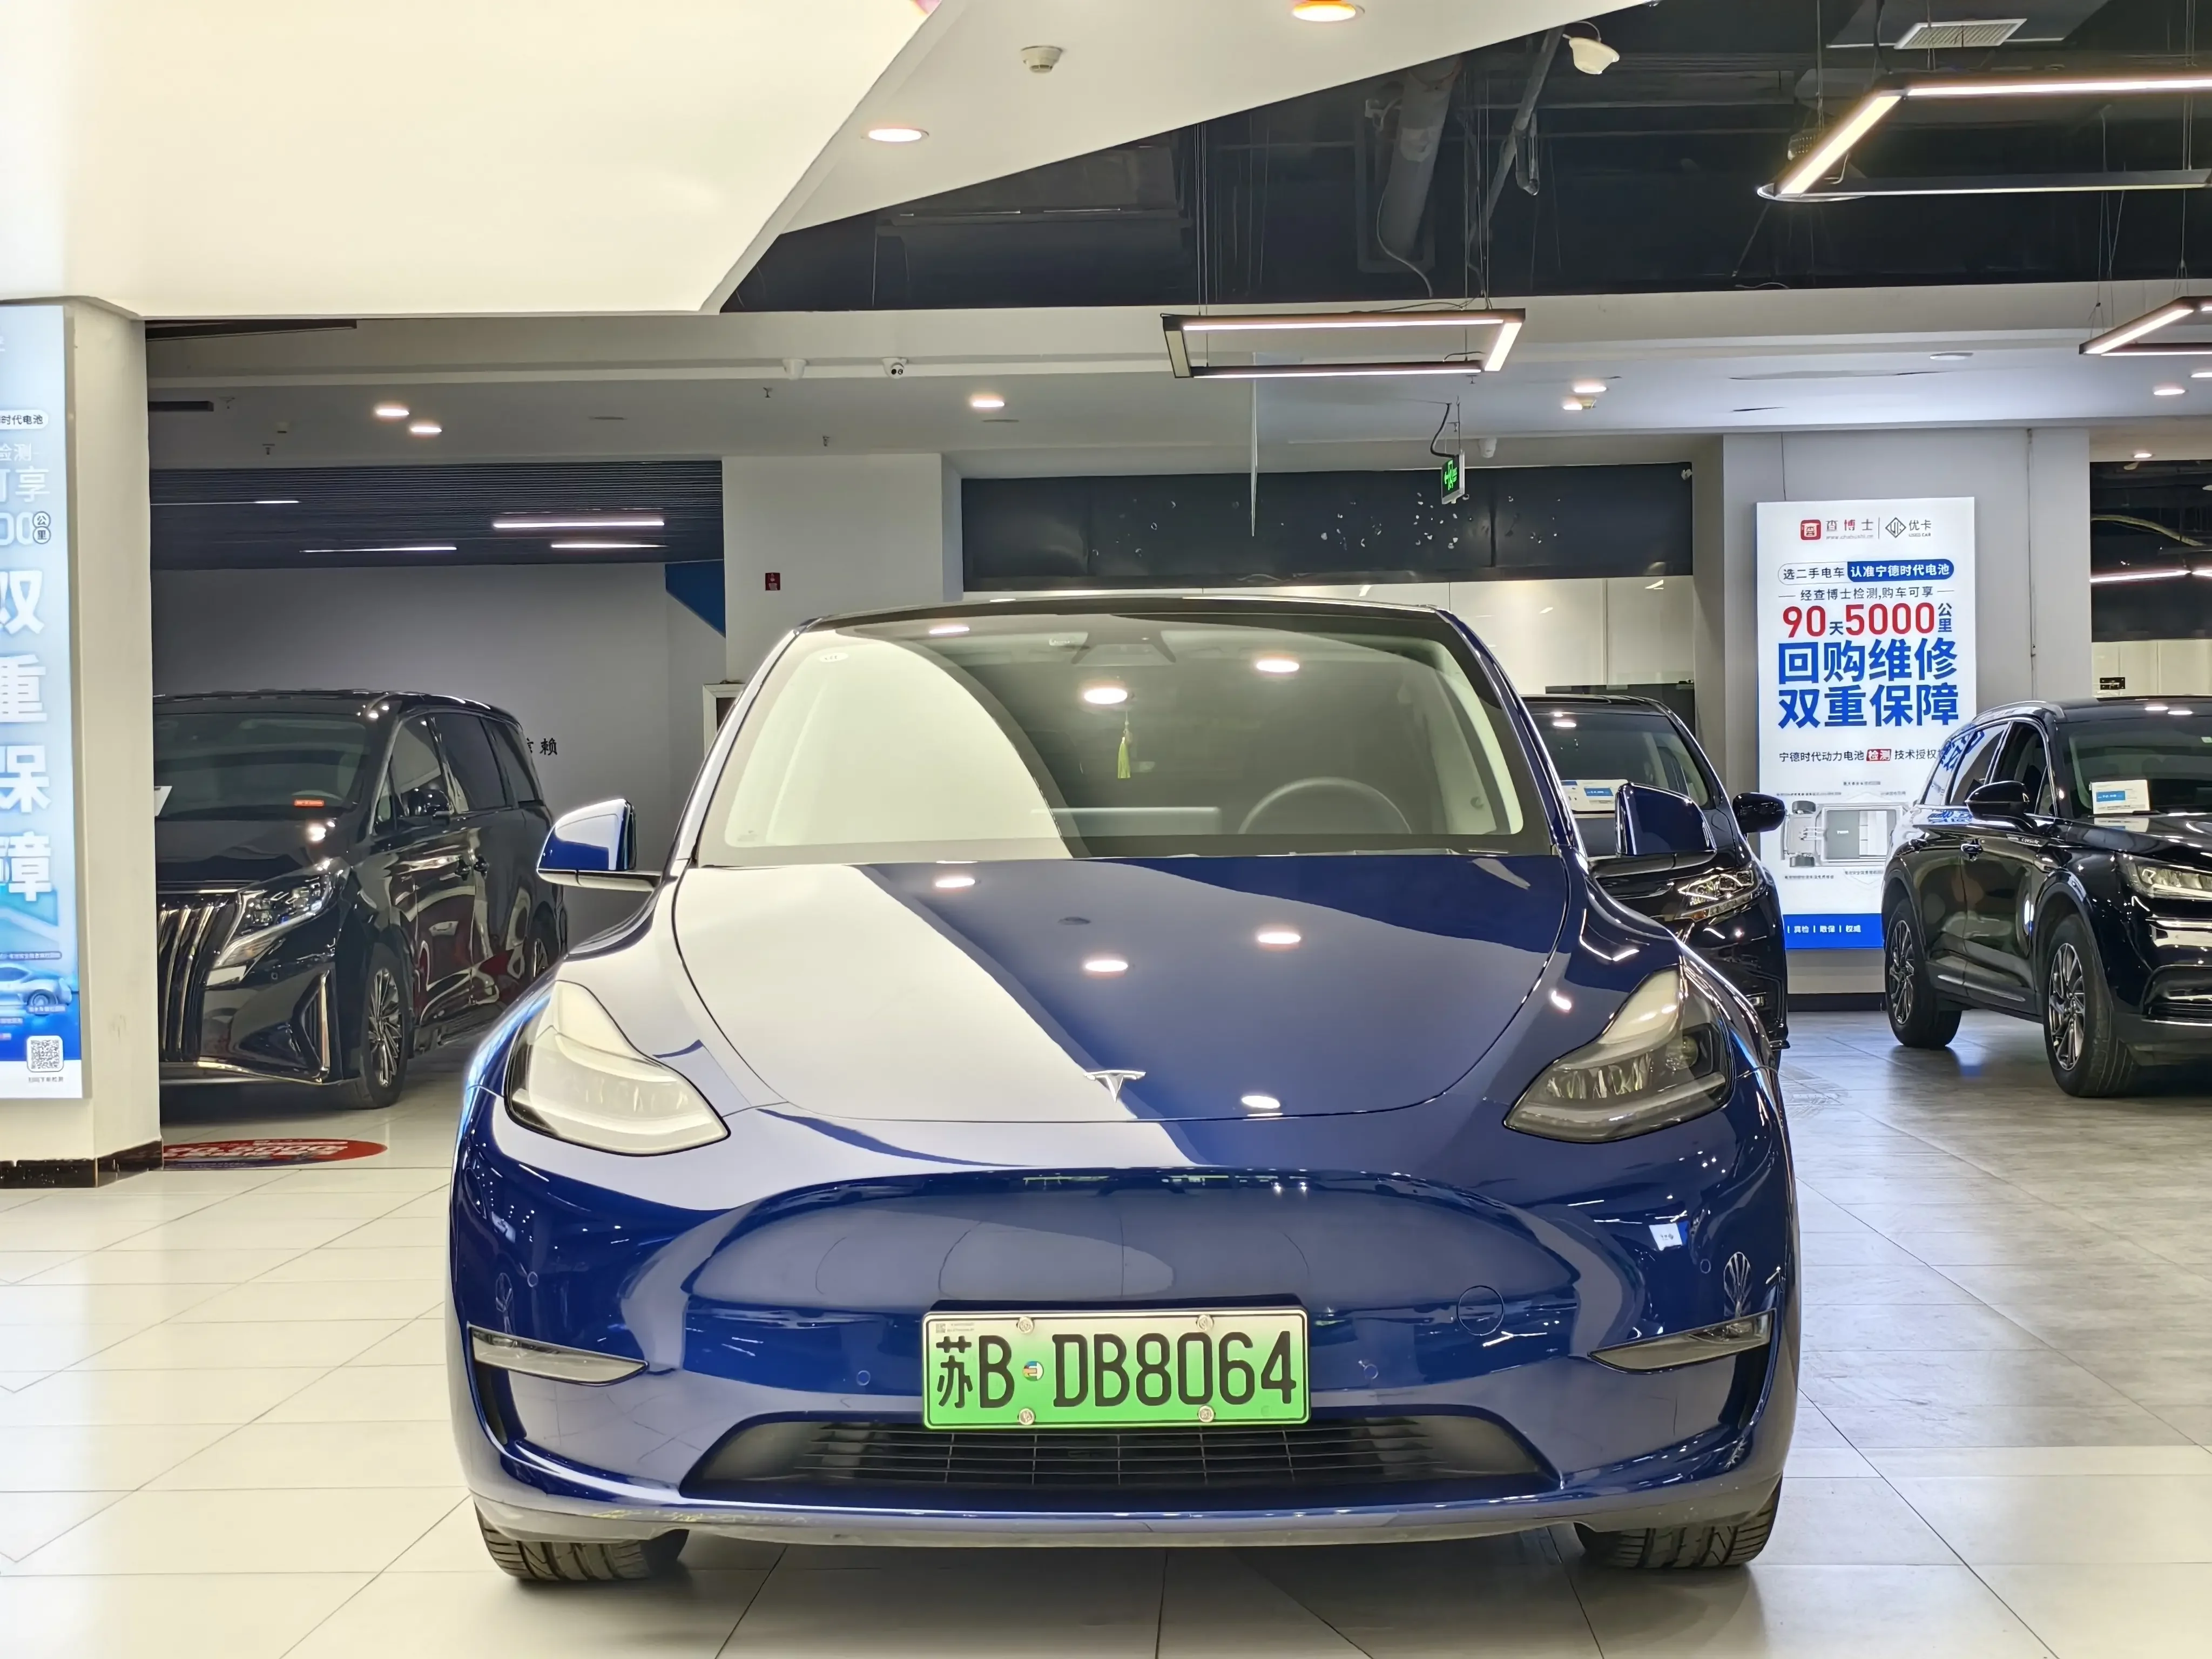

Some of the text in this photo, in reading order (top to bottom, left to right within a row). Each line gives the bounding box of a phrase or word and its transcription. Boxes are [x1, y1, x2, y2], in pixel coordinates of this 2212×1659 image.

[1908, 519, 1932, 531] 优卡
[1783, 563, 1950, 580] 选二手电车 认准宁德时代电池
[1778, 638, 1958, 684] 回购维修
[1778, 683, 1959, 729] 双重保障
[1779, 749, 1943, 763] 宁德时代动力电池 检测 技术授权
[1052, 1330, 1297, 1407] DB8064
